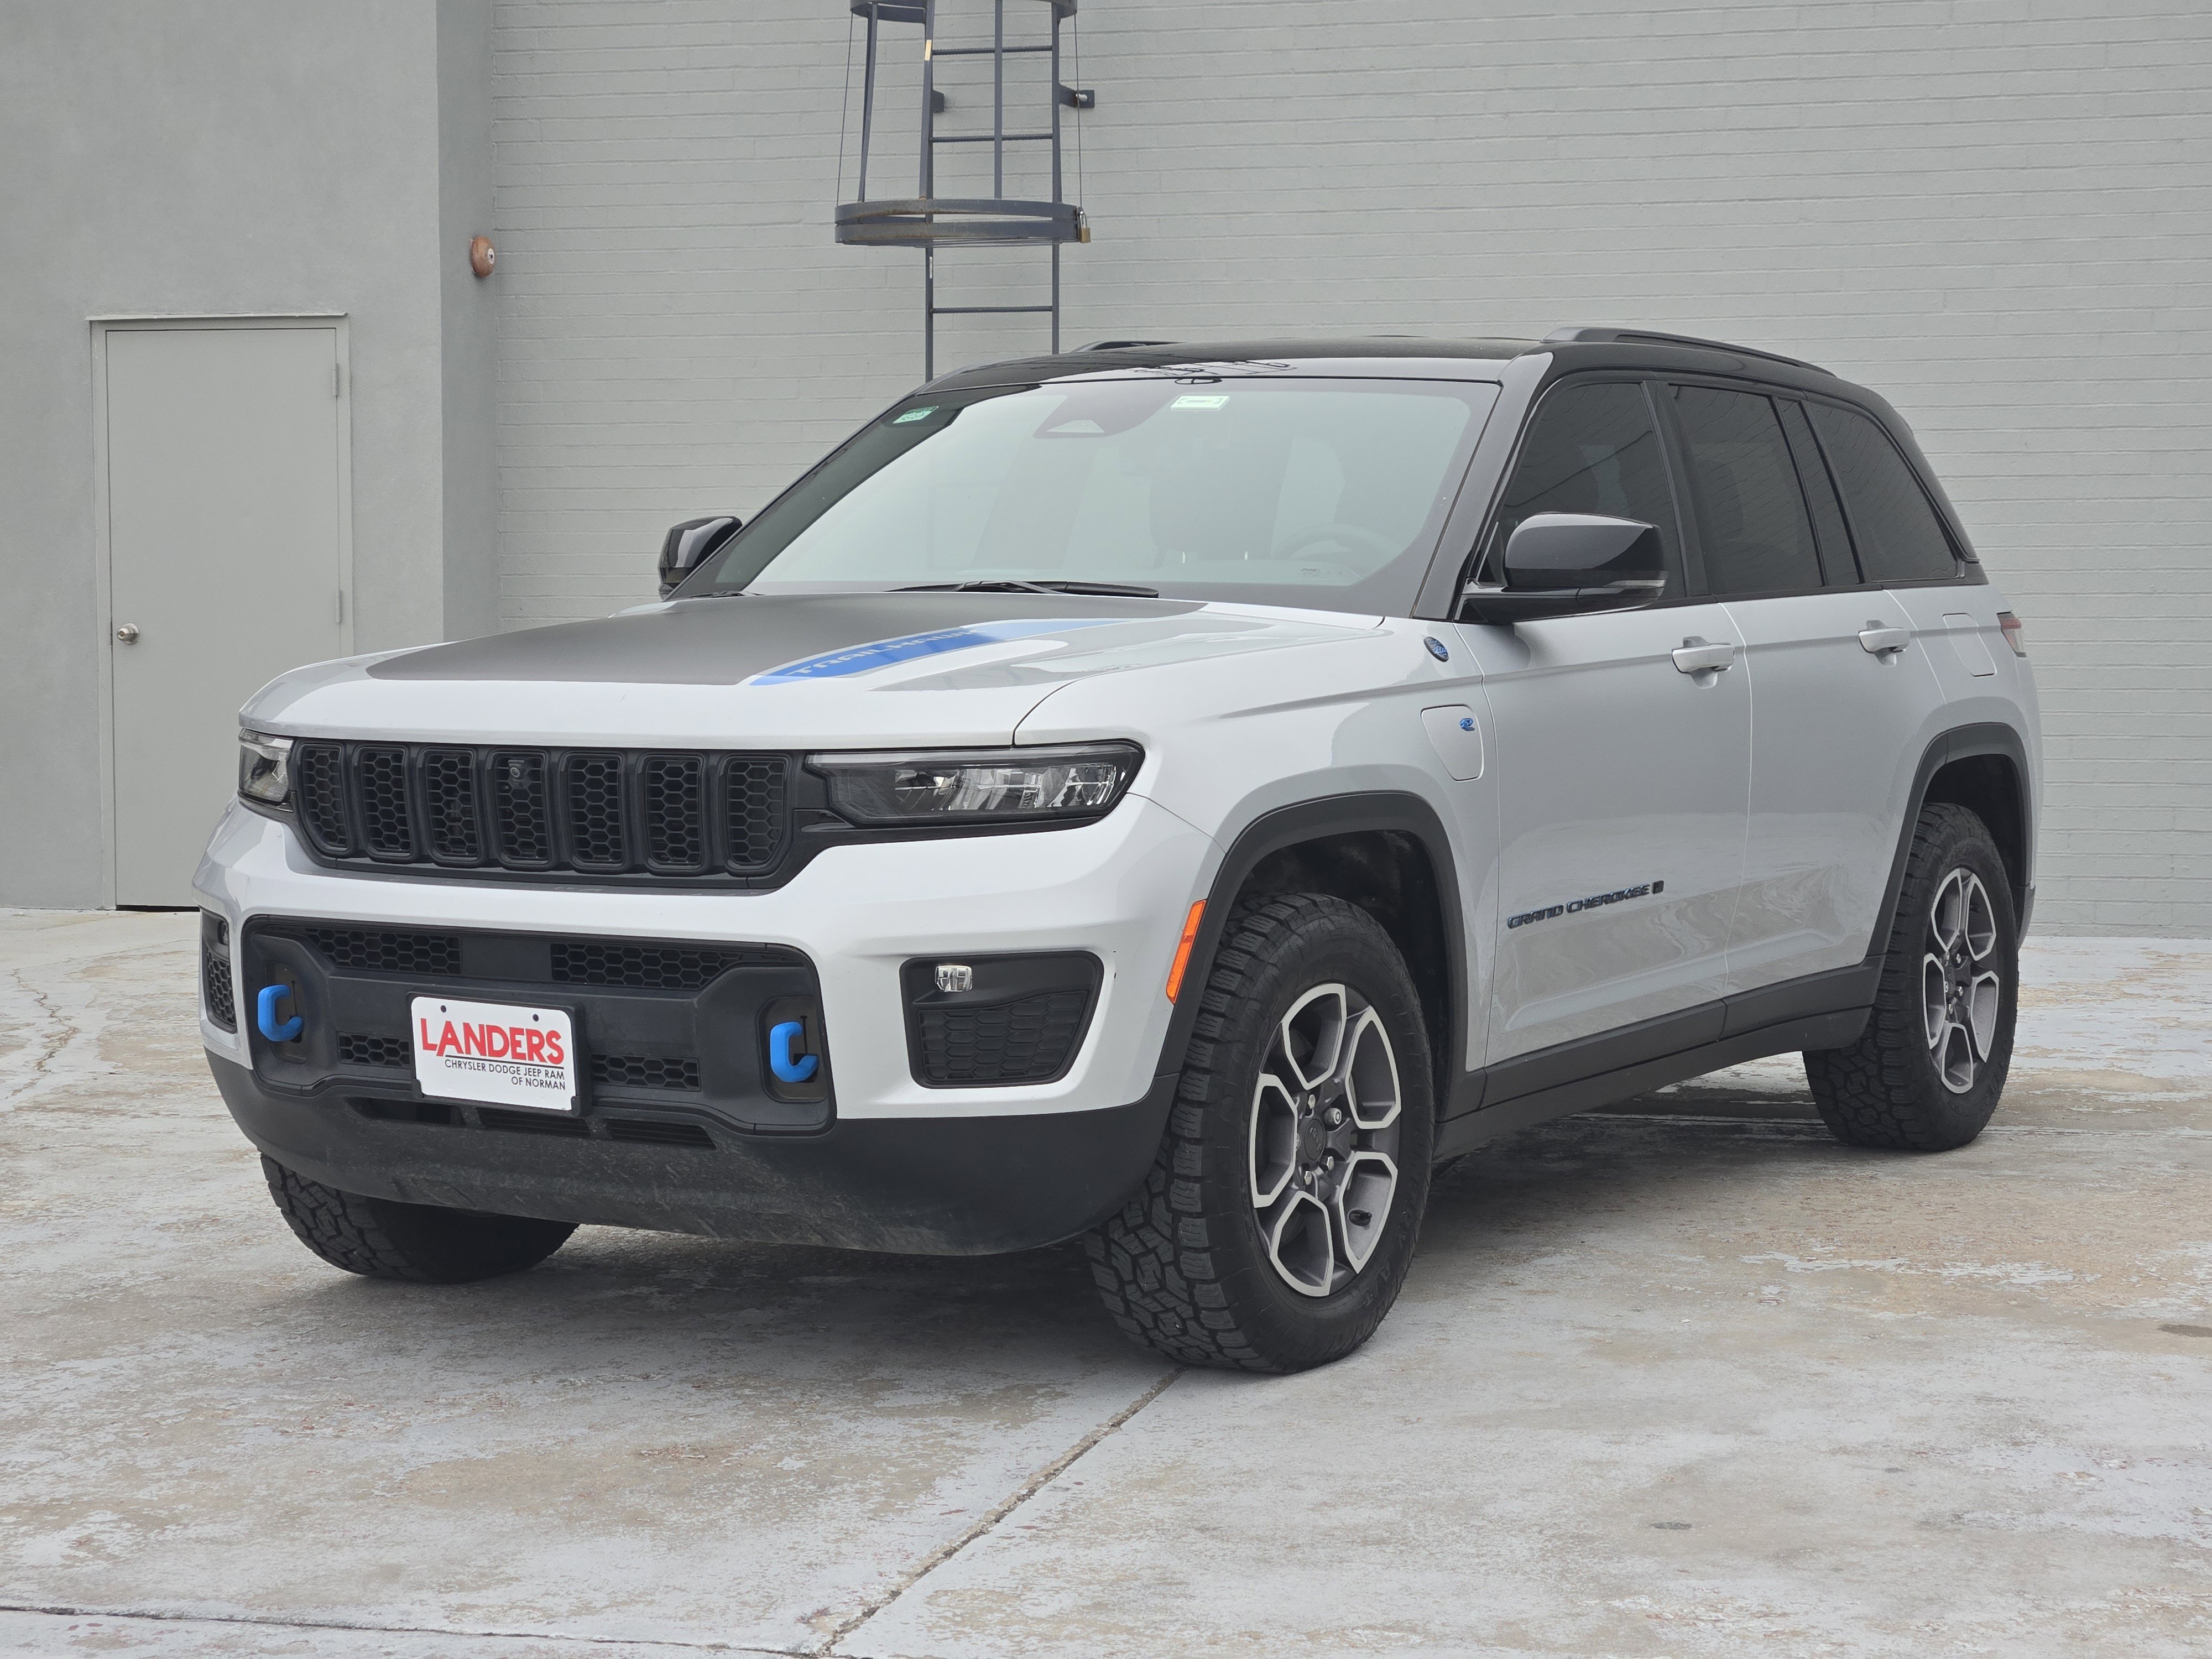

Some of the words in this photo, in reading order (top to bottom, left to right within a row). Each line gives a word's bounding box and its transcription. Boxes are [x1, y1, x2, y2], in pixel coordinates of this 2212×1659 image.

[785, 628, 983, 676] TRAILHAWK
[1507, 905, 1564, 929] GRAND
[1566, 884, 1650, 913] CHEROKEE
[421, 1018, 564, 1065] LANDERS
[445, 1059, 486, 1072] CHRYSLER
[489, 1065, 521, 1076] DODGE
[523, 1069, 542, 1077] JEEP
[545, 1071, 565, 1081] RAM
[511, 1077, 524, 1086] OF
[526, 1078, 565, 1091] NORMAN
